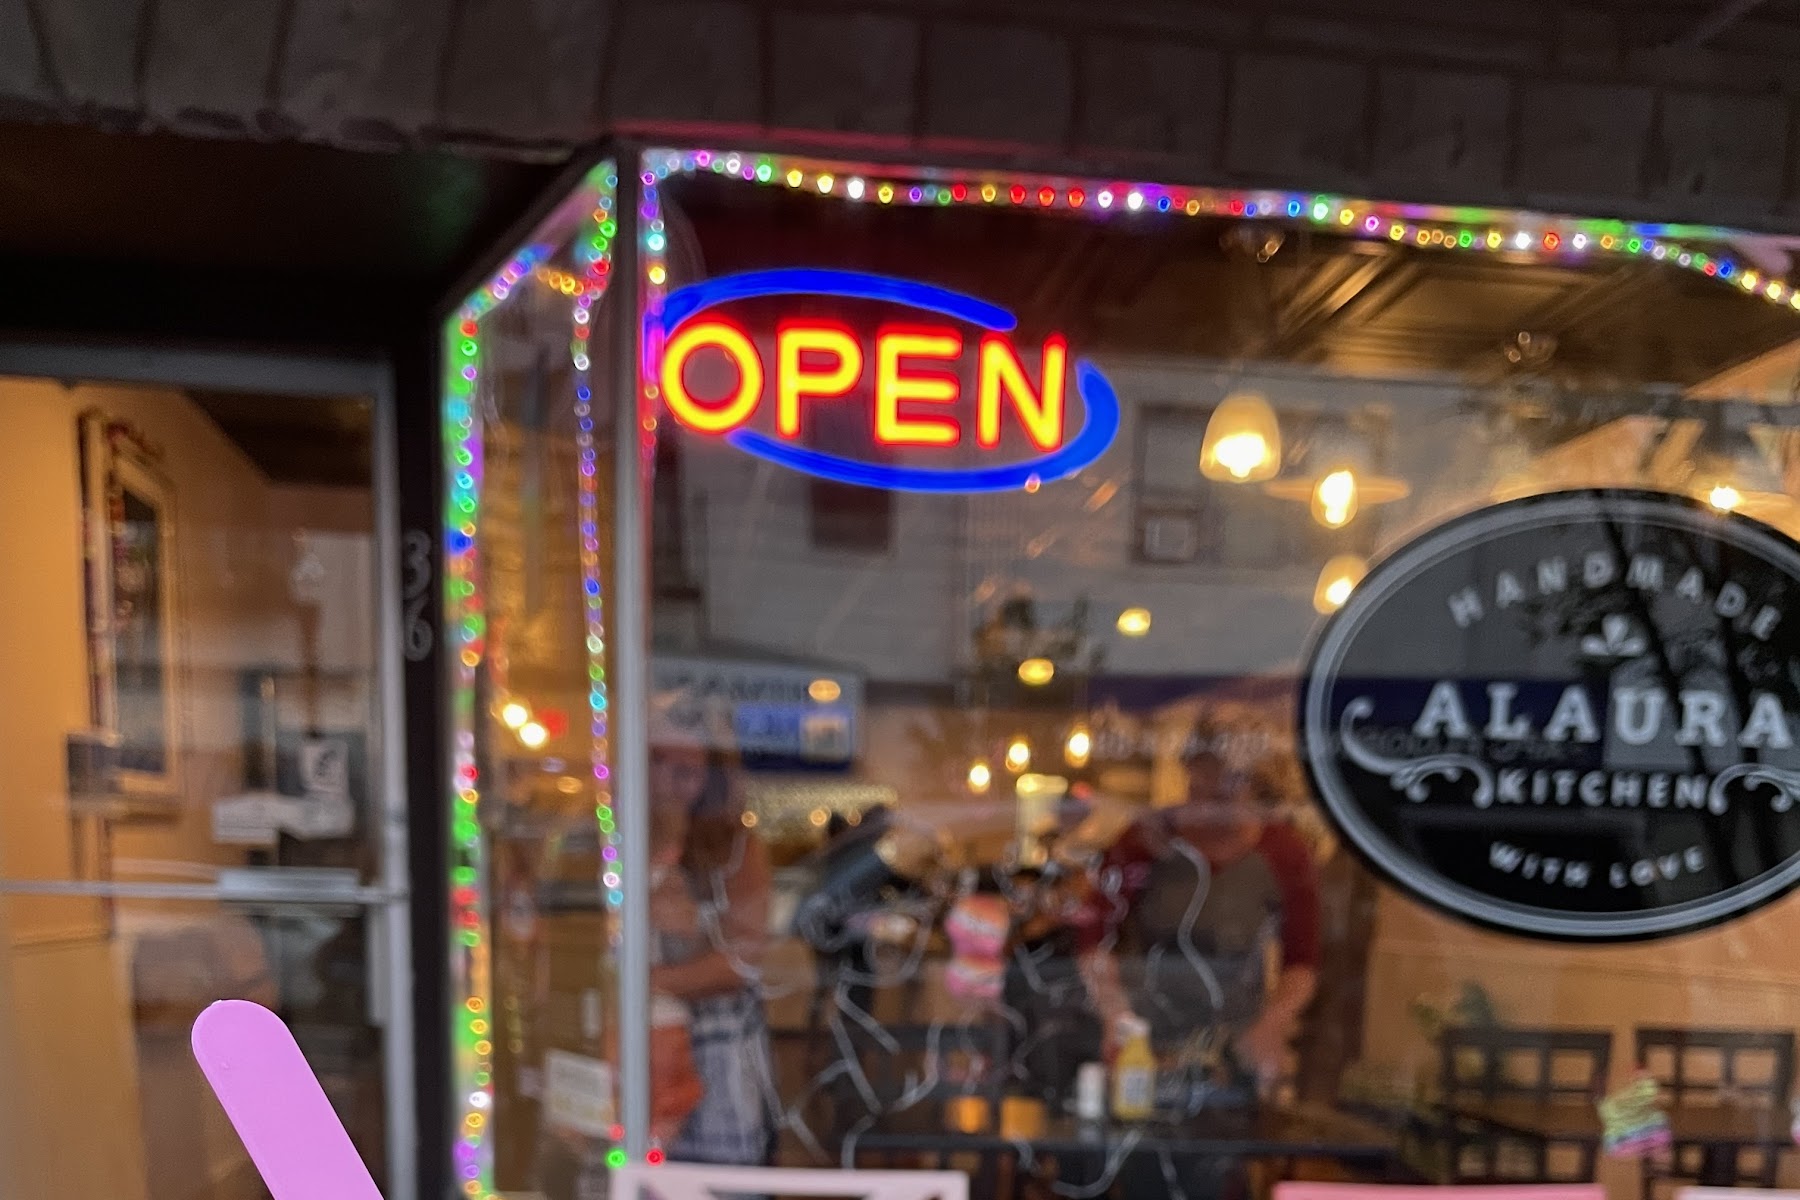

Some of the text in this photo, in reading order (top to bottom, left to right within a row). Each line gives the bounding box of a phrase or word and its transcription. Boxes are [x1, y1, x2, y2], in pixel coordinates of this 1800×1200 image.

[660, 311, 1067, 453] OPEN
[402, 528, 434, 662] 36
[1449, 551, 1782, 641] HANDMADE
[1412, 681, 1794, 749] ALAURA
[1498, 769, 1708, 809] KITCHEN
[1489, 841, 1704, 889] WITH LOVE
